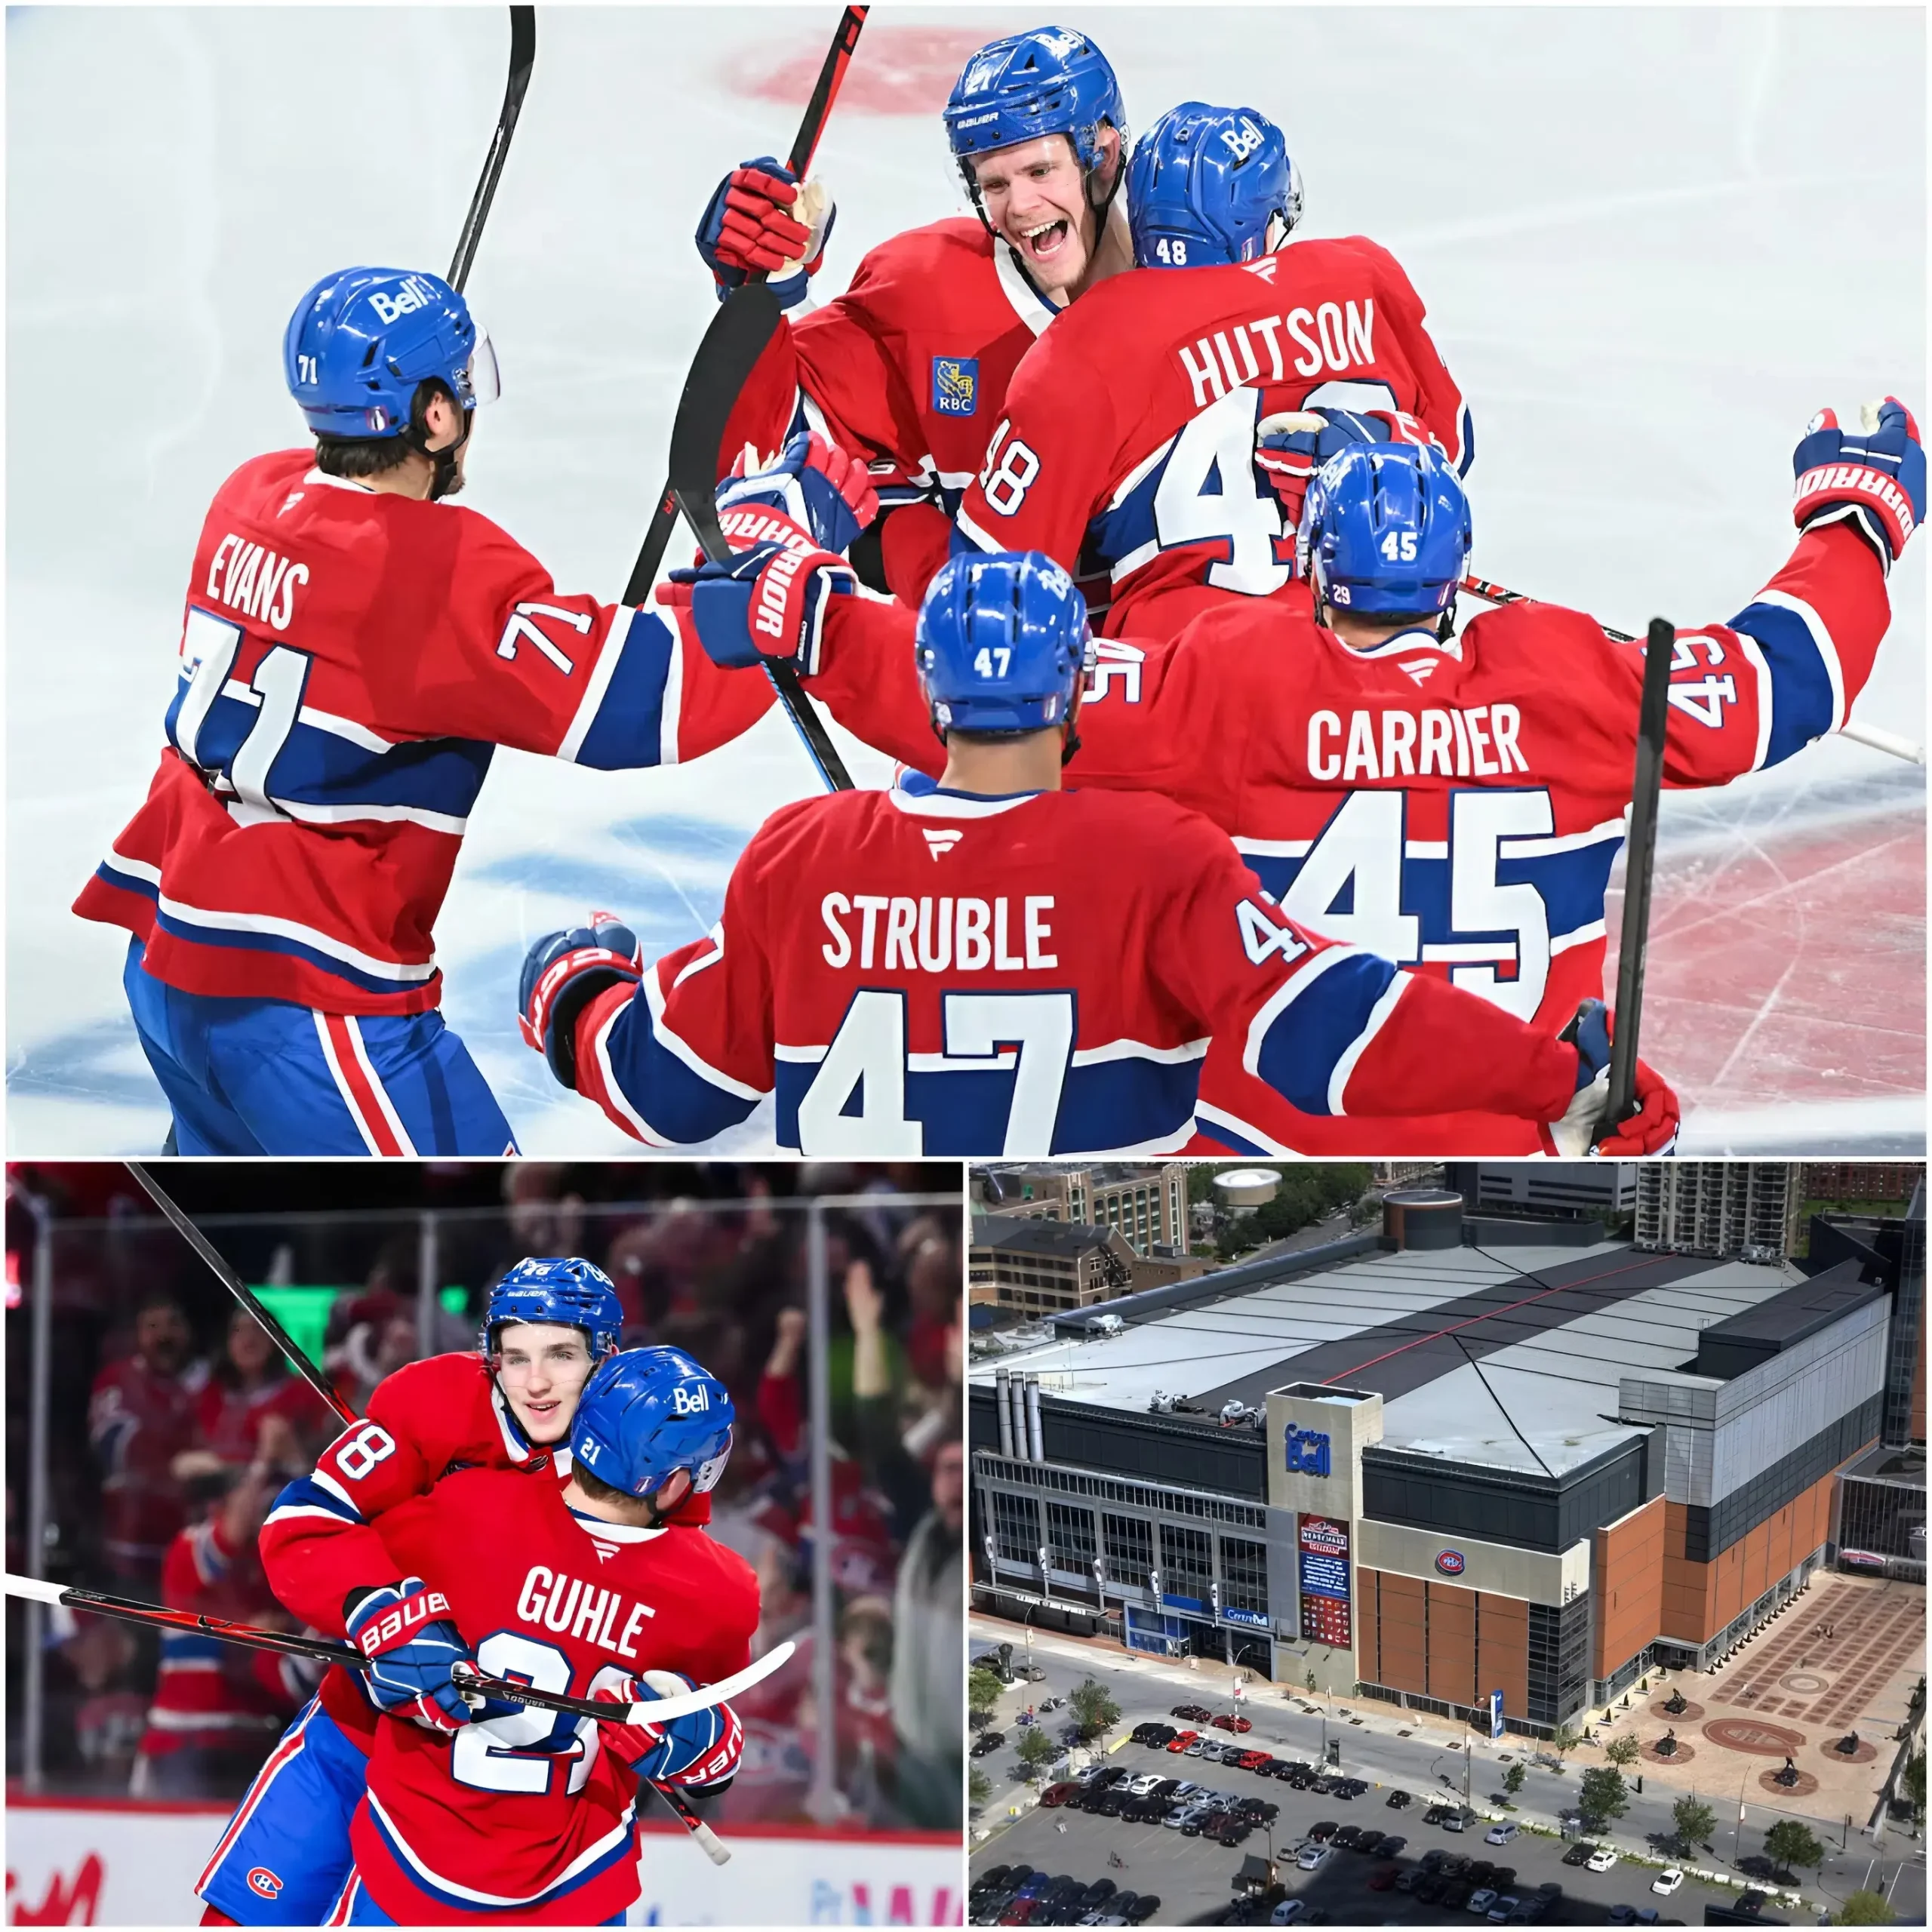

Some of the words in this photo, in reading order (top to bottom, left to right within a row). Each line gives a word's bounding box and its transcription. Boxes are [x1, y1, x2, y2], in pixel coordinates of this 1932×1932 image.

[1220, 115, 1266, 161] Bell
[1155, 238, 1187, 266] 48
[368, 278, 429, 325] Bell
[298, 355, 318, 385] 71
[1179, 298, 1377, 408] HUTSON
[939, 397, 972, 411] RBC
[1380, 531, 1418, 561] 45
[206, 532, 310, 632] EVANS
[1332, 583, 1351, 605] 29
[496, 601, 595, 676] 71
[974, 647, 1011, 678] 47
[175, 604, 315, 821] 71
[1307, 703, 1530, 781] CARRIER
[1278, 787, 1556, 1024] 45
[820, 891, 1058, 973] STRUBLE
[797, 986, 1078, 1157] 47
[672, 1384, 709, 1414] Bell
[580, 1436, 601, 1466] 21
[517, 1565, 656, 1658] GUHLE
